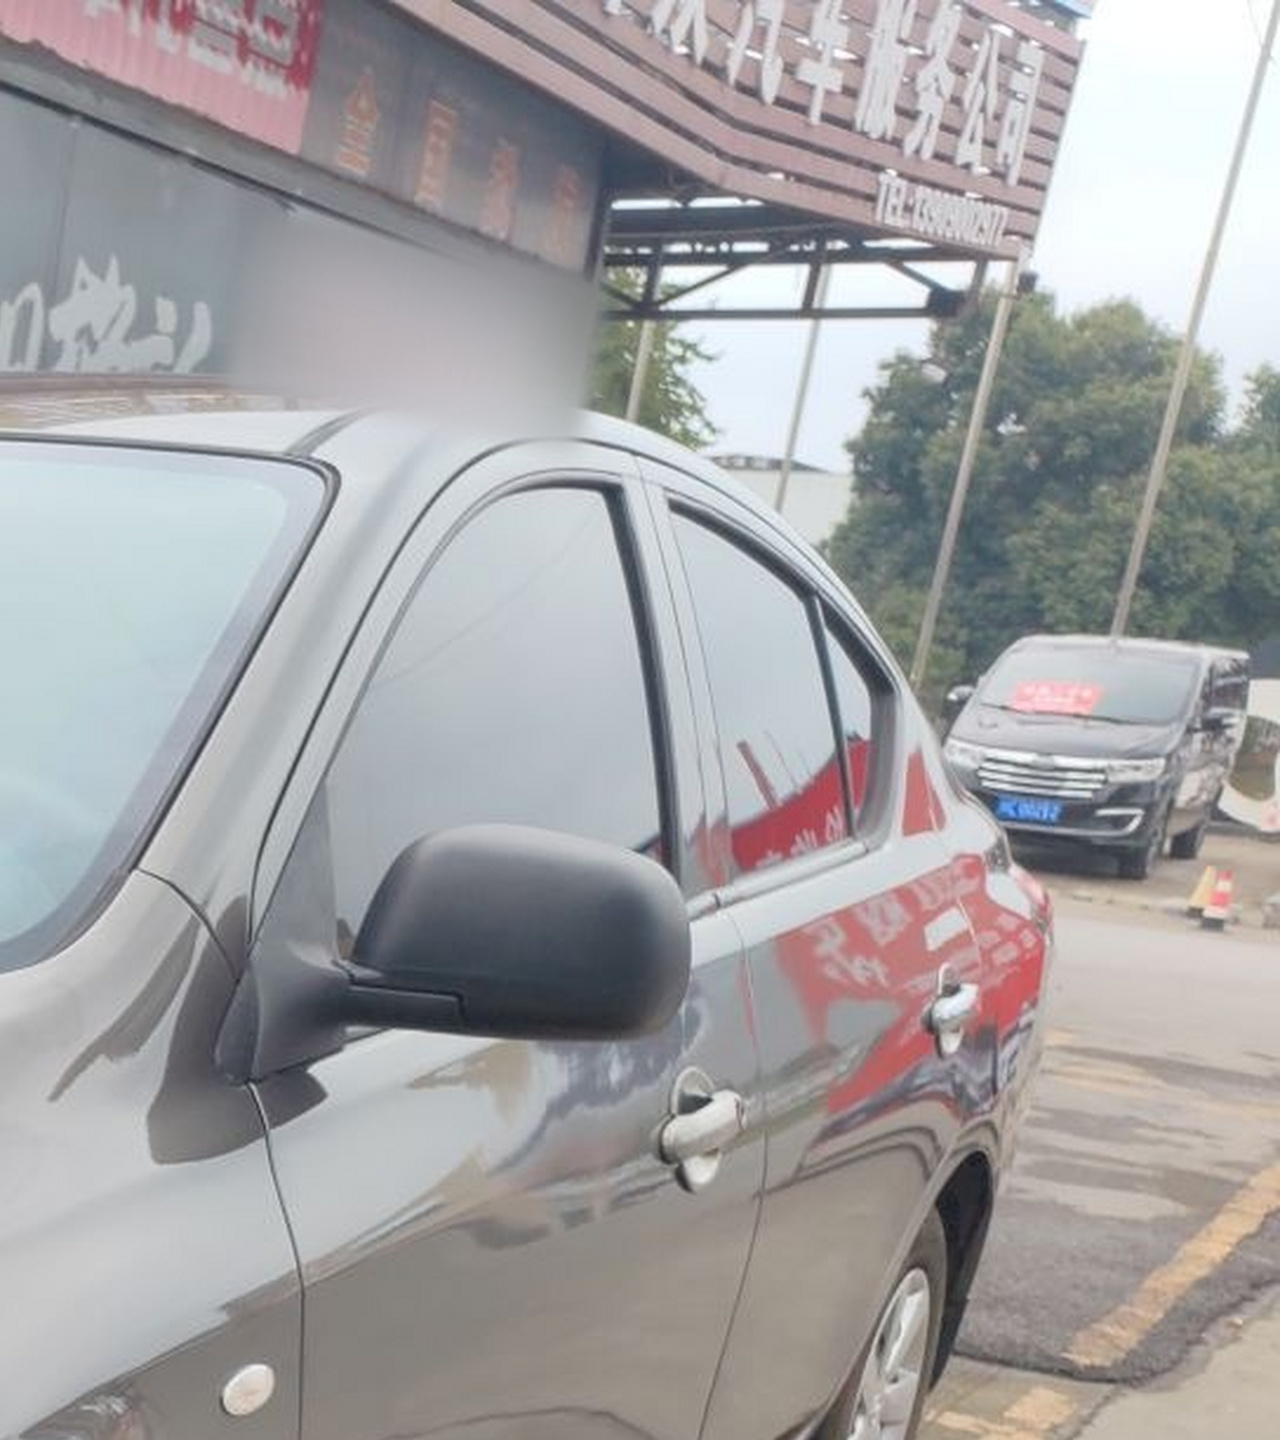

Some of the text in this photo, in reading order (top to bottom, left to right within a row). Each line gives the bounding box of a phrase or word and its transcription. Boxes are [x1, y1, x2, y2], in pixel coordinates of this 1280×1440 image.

[646, 0, 1043, 187] 汽车服务公司
